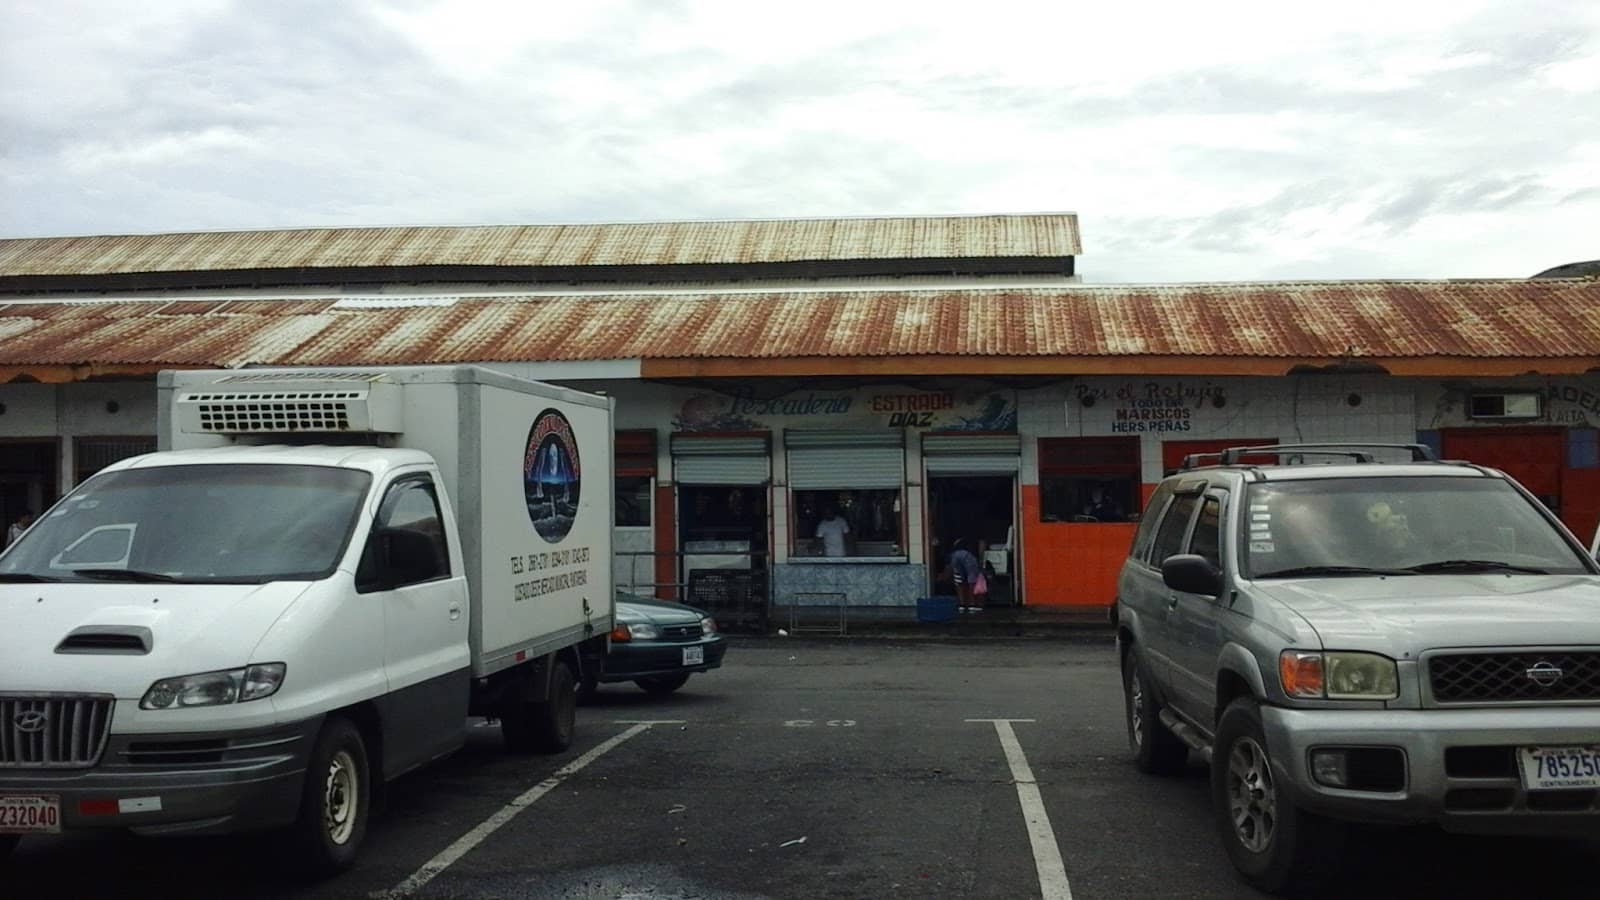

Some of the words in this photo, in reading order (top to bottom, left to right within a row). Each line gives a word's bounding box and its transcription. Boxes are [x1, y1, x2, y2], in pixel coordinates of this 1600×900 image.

[872, 393, 953, 411] ESTRADA
[1130, 398, 1163, 408] TODO
[1116, 408, 1191, 420] MARISCOS
